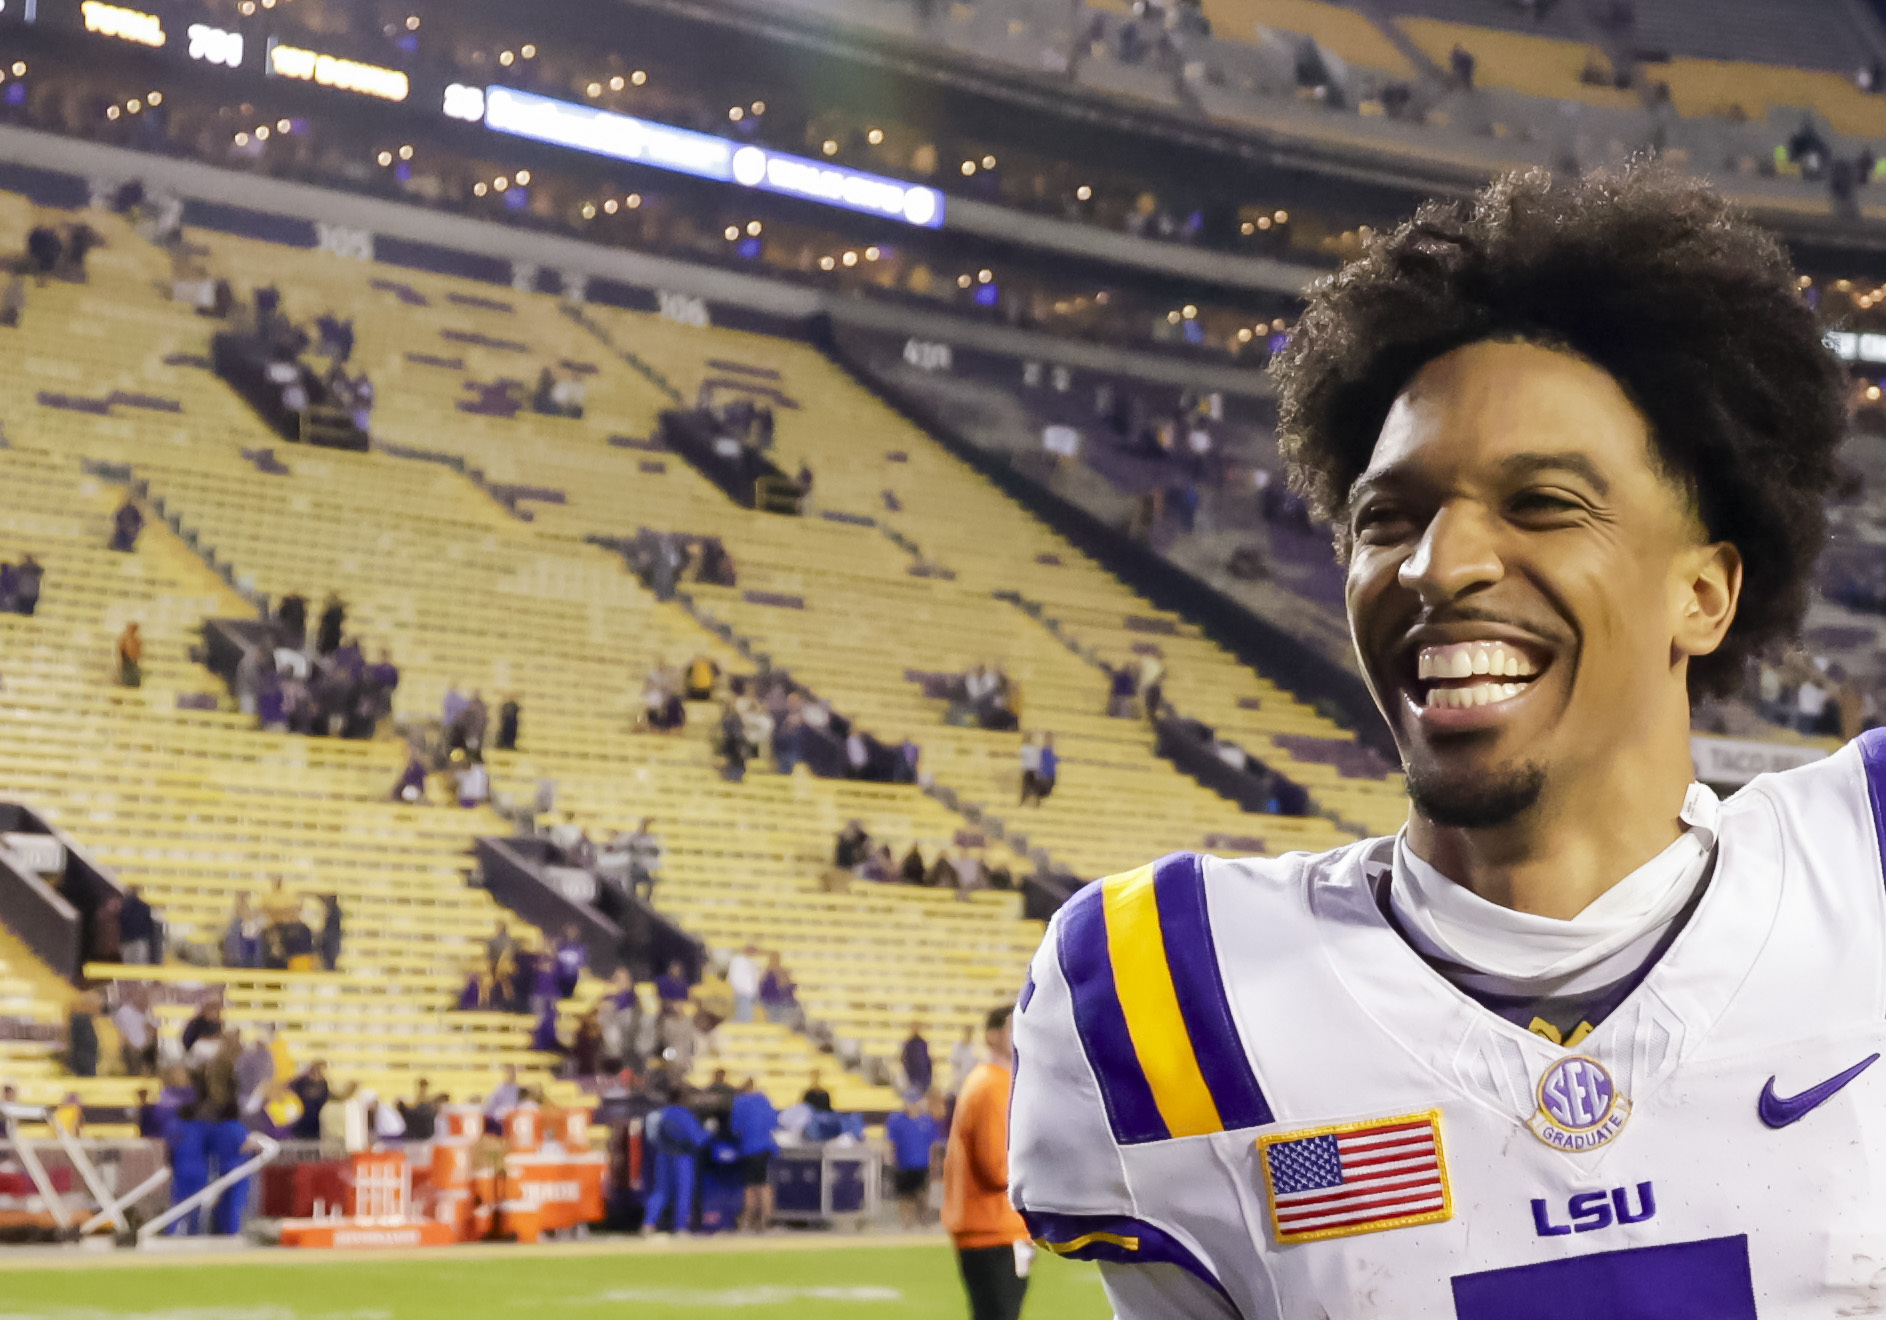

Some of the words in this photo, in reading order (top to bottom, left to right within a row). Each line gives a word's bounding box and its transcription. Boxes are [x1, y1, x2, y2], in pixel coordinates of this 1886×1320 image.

[1545, 1061, 1609, 1126] SEC
[1542, 1114, 1623, 1150] GRADUATE
[1530, 1181, 1656, 1238] LSU
